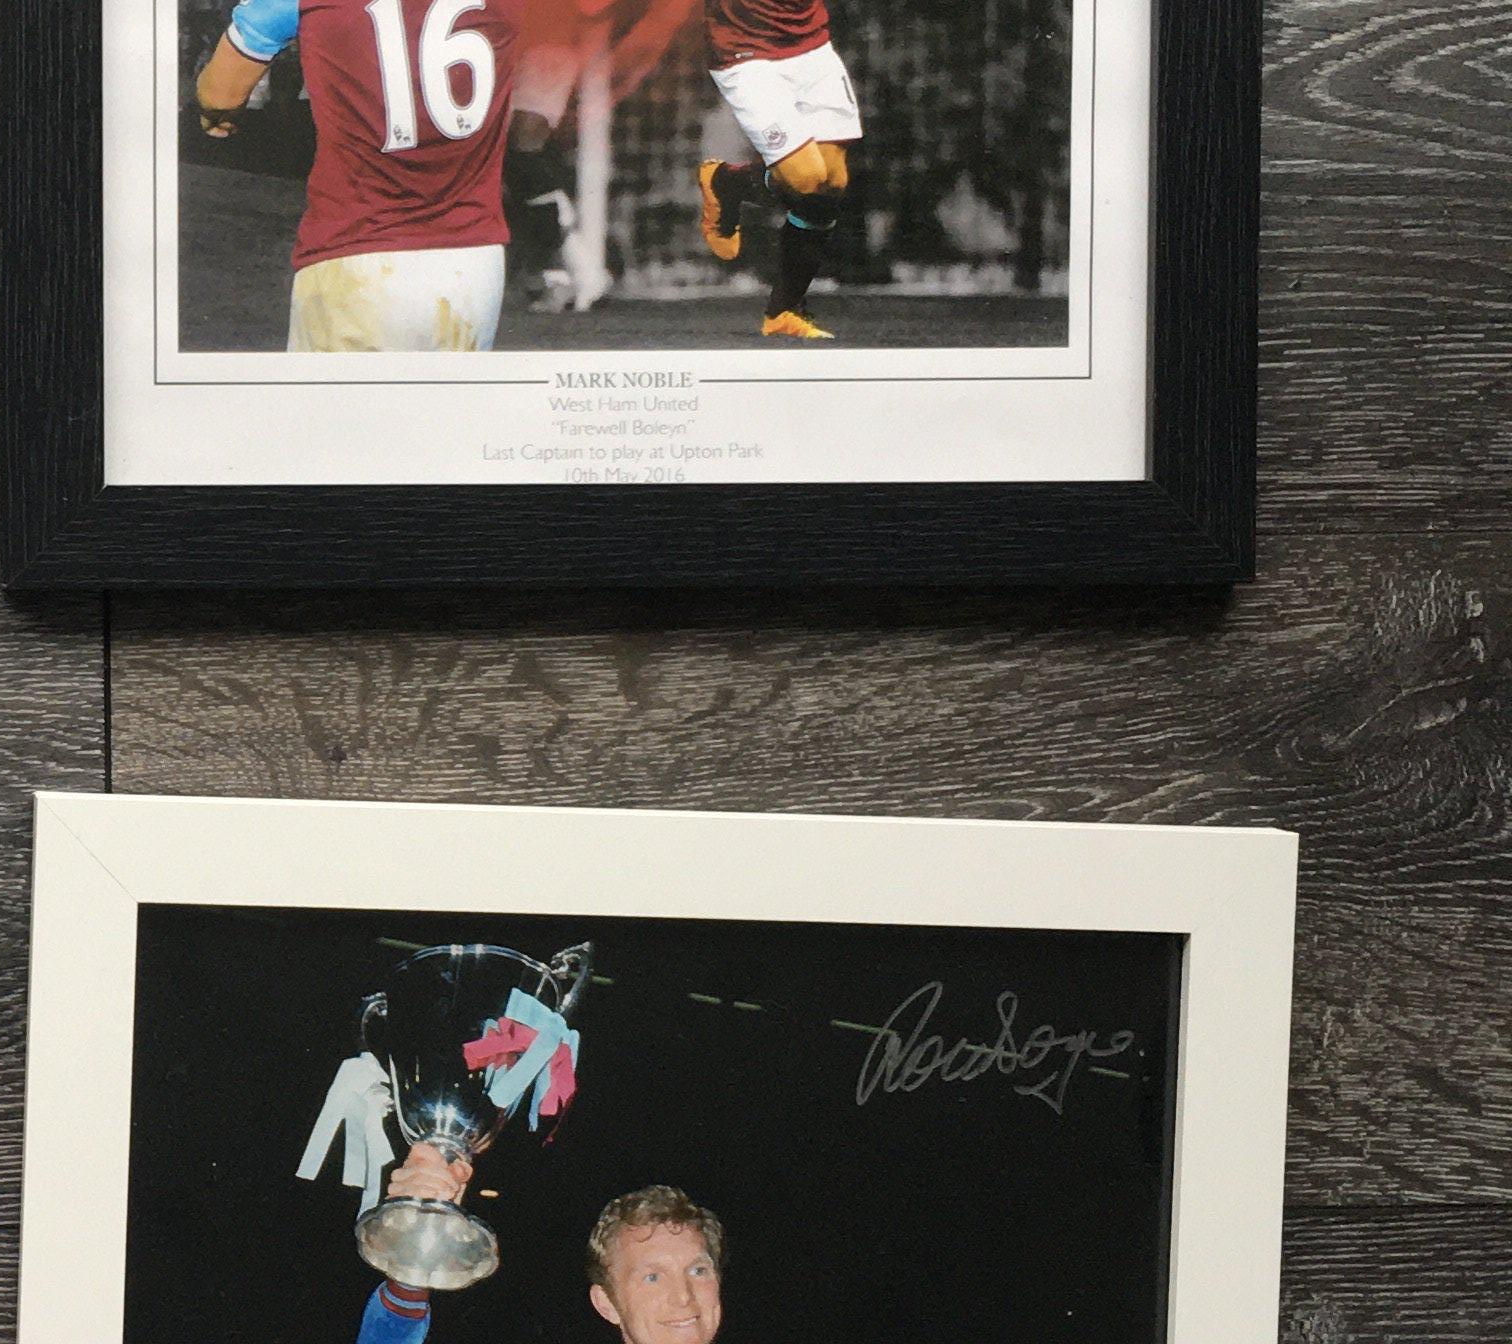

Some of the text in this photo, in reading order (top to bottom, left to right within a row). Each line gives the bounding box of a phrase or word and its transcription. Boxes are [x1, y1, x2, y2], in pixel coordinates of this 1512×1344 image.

[555, 372, 693, 388] MARK NOBLE
[548, 396, 698, 412] West Ham United
[483, 443, 764, 464] Last Captain to play at Upton Park
[565, 467, 685, 483] 10th May 2016
